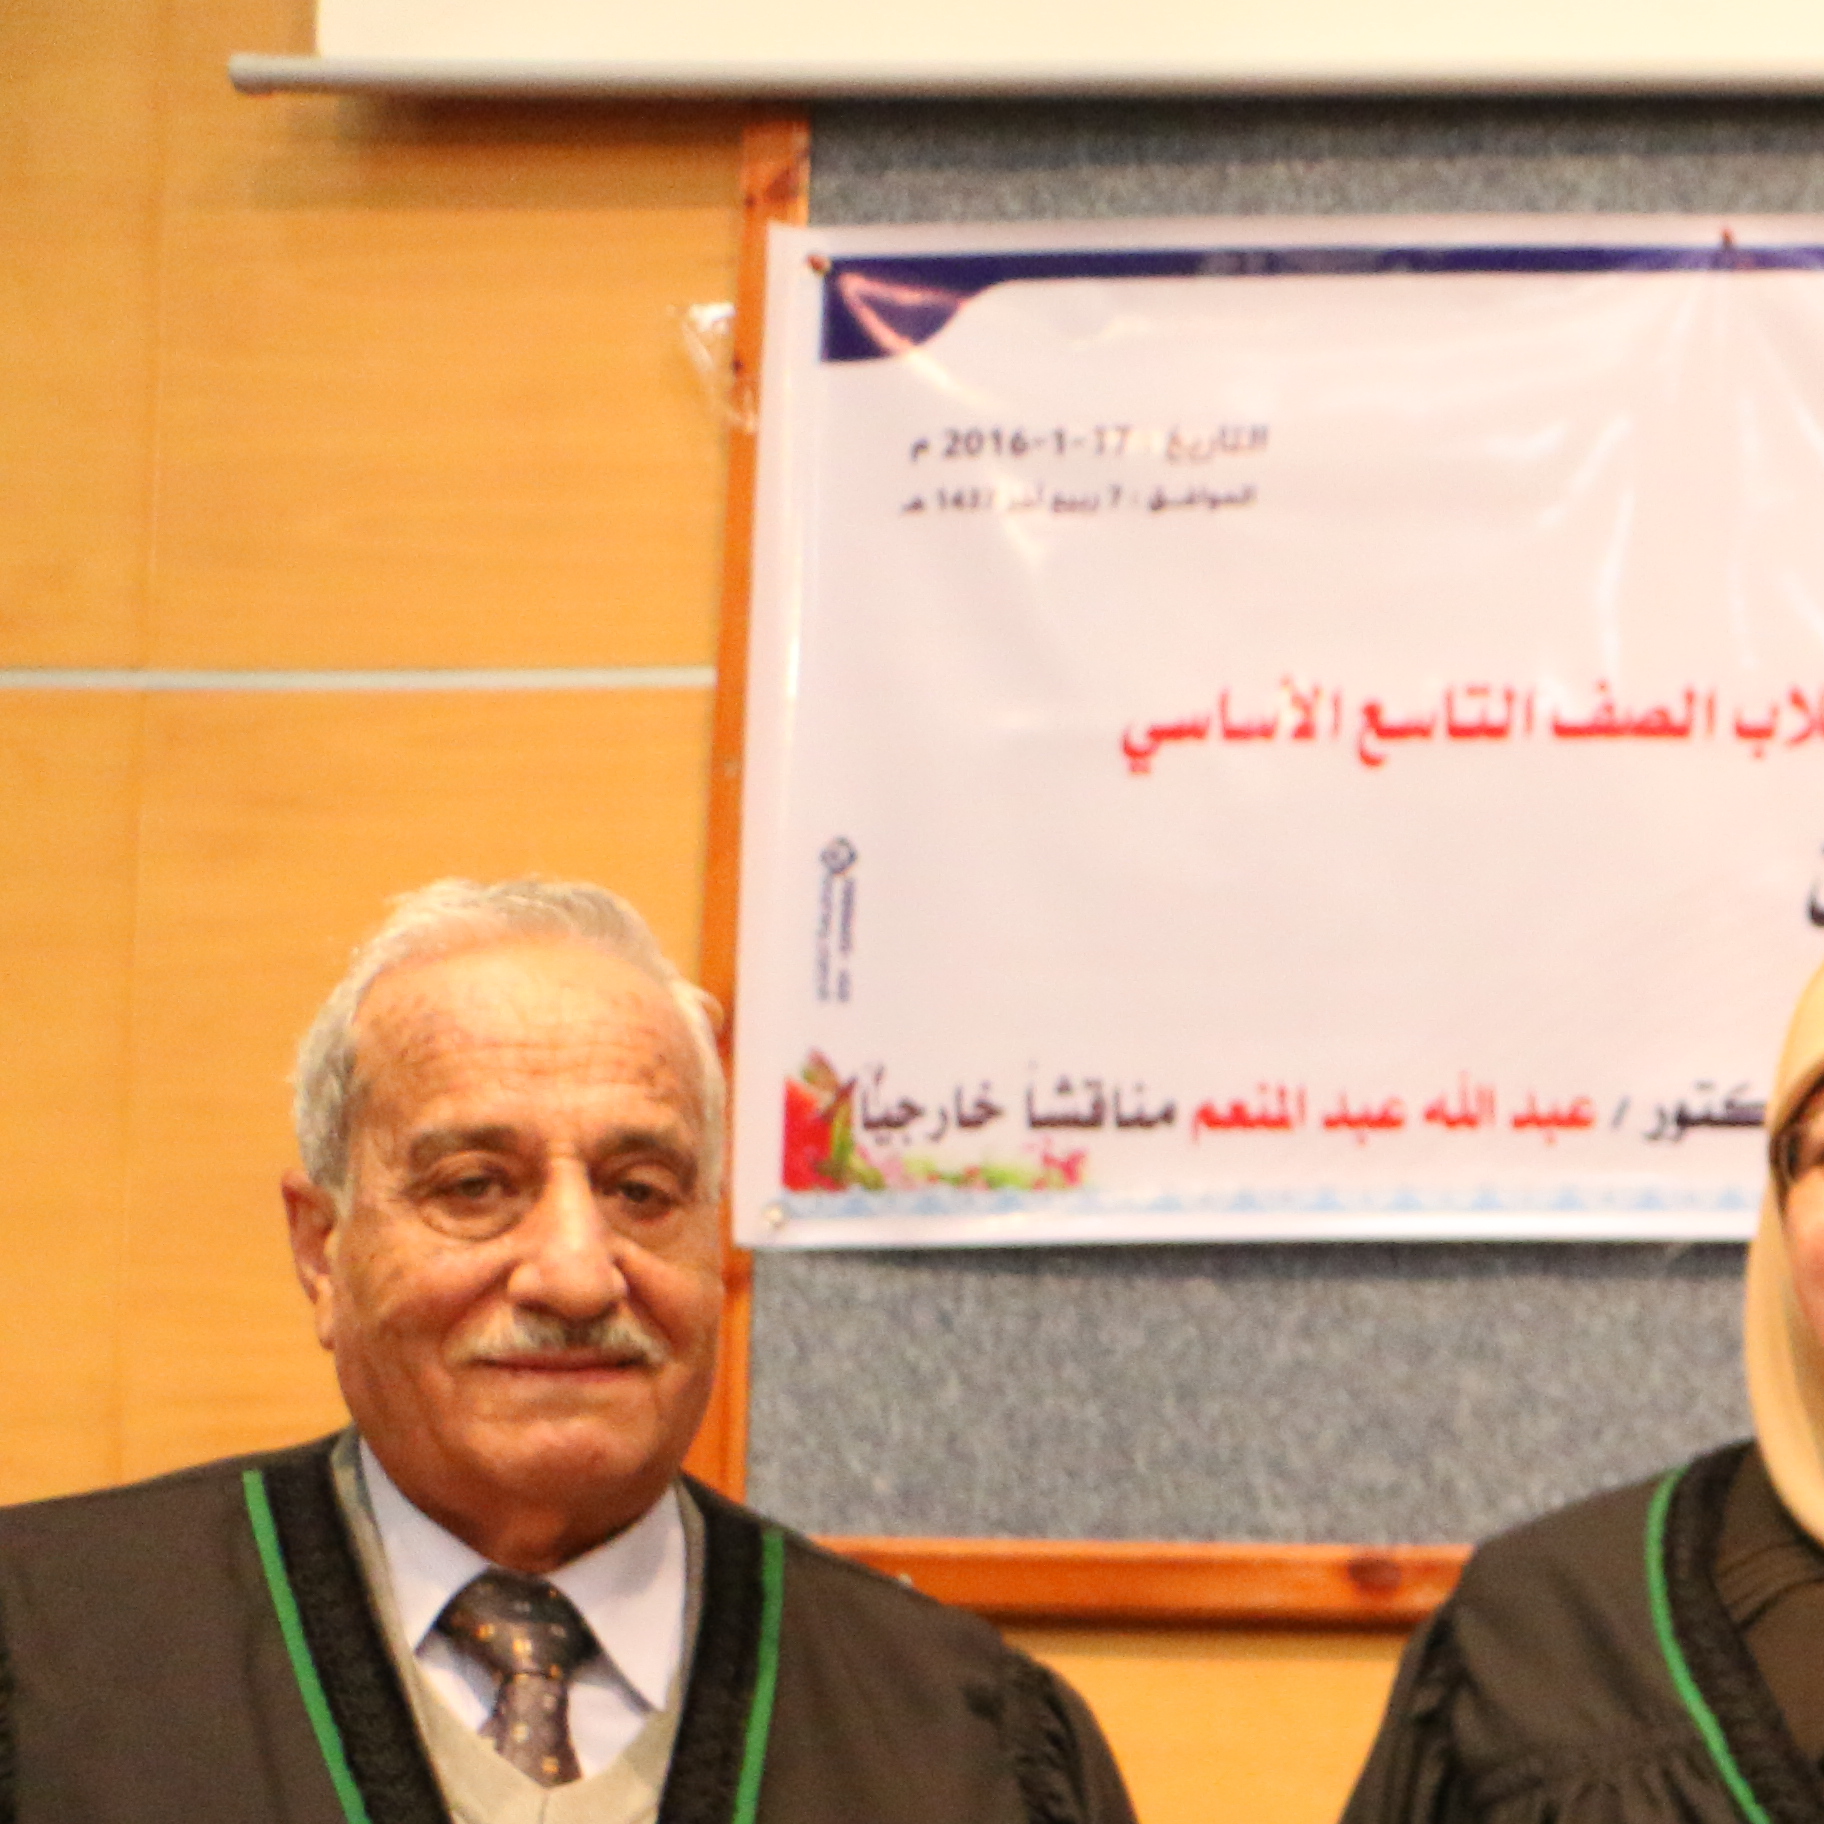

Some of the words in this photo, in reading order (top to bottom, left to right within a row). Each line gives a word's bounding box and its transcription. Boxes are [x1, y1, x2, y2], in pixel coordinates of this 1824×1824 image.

[1119, 678, 1341, 777] الأساسي
[1356, 686, 1534, 771] التاسع
[1549, 681, 1716, 743] الصف
[1191, 1082, 1308, 1144] المنعم
[1320, 1090, 1406, 1148] عبد
[1421, 1070, 1498, 1132] الله
[1510, 1090, 1597, 1148] عبد
